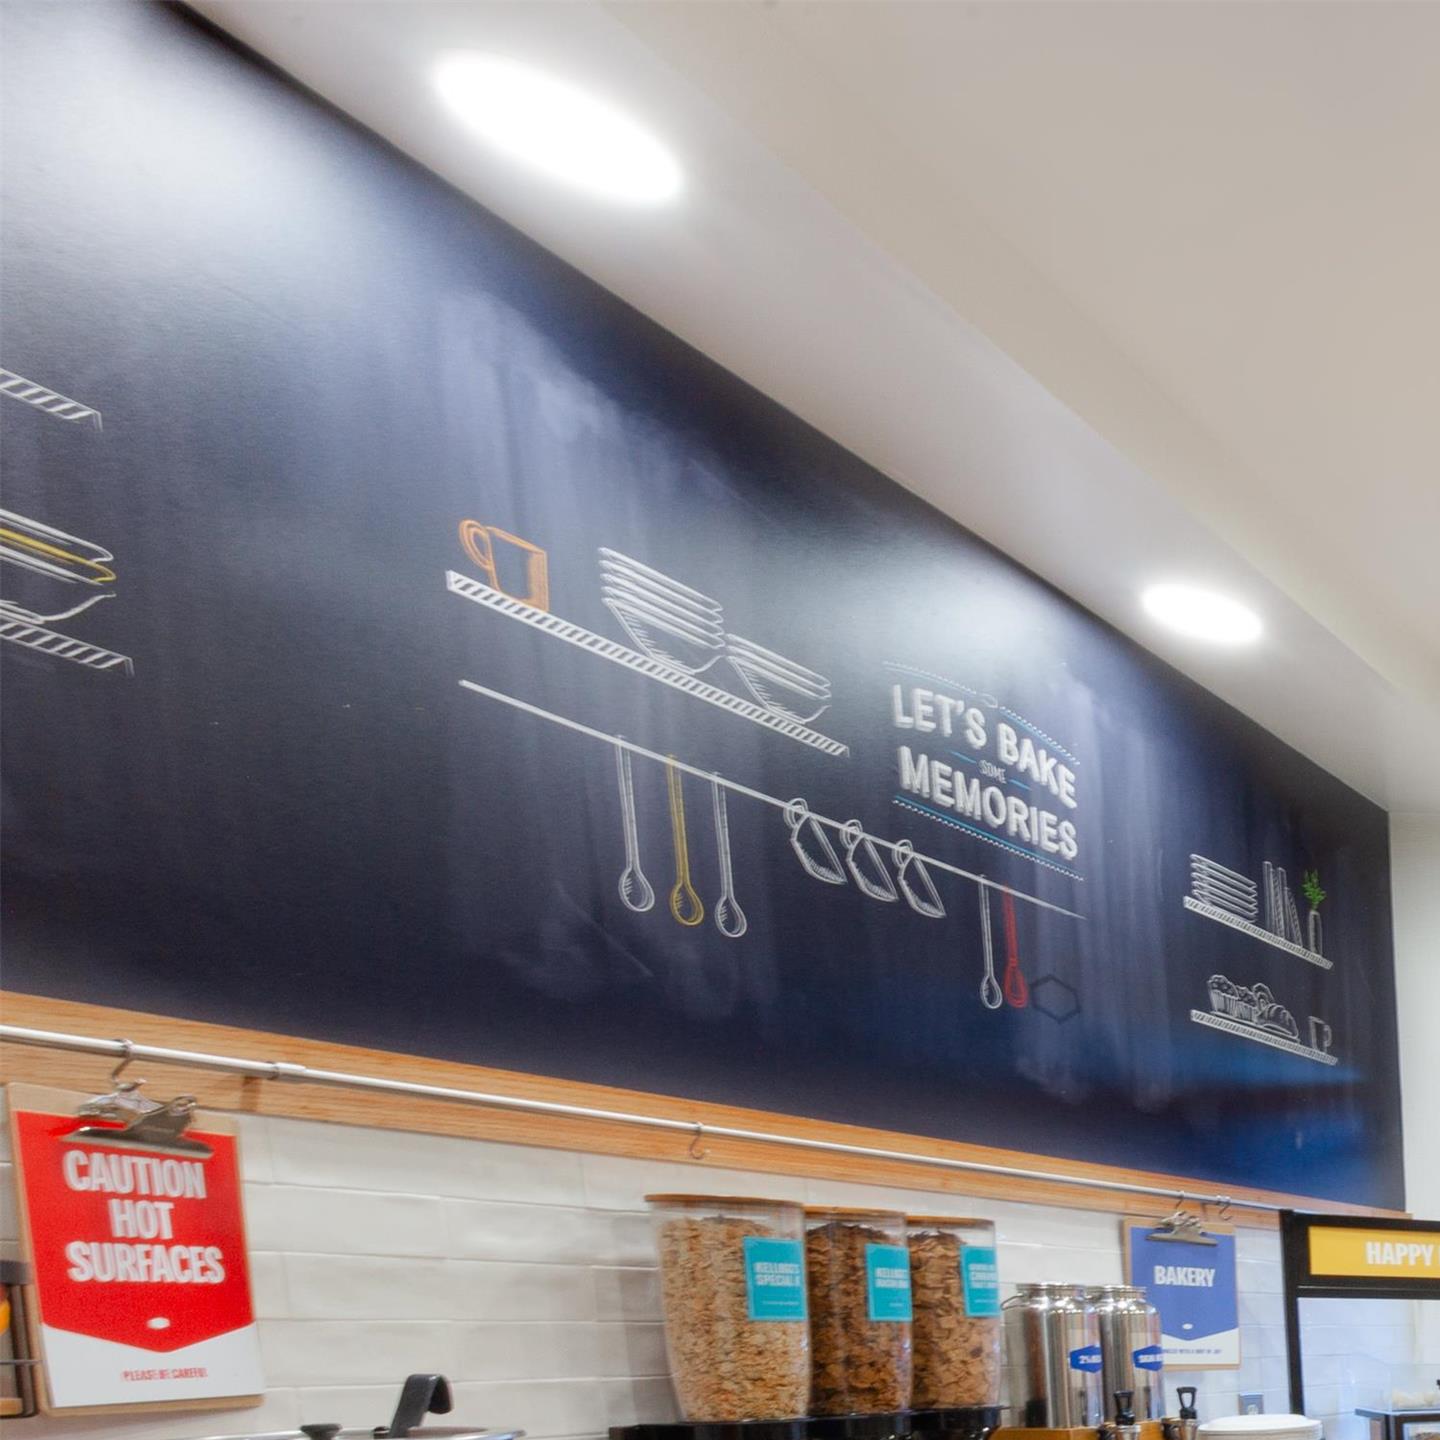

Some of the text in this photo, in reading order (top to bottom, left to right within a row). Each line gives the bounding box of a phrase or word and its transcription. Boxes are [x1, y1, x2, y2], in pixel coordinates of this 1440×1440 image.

[893, 684, 1077, 808] LET'S BAKE
[978, 760, 1006, 784] SOME
[898, 745, 1078, 861] MEMORIES
[63, 1150, 208, 1199] CAUTION
[108, 1198, 174, 1240] HOT
[65, 1241, 226, 1284] SURFACES
[1365, 1241, 1434, 1266] HAPPY
[1154, 1265, 1215, 1287] BAKERY
